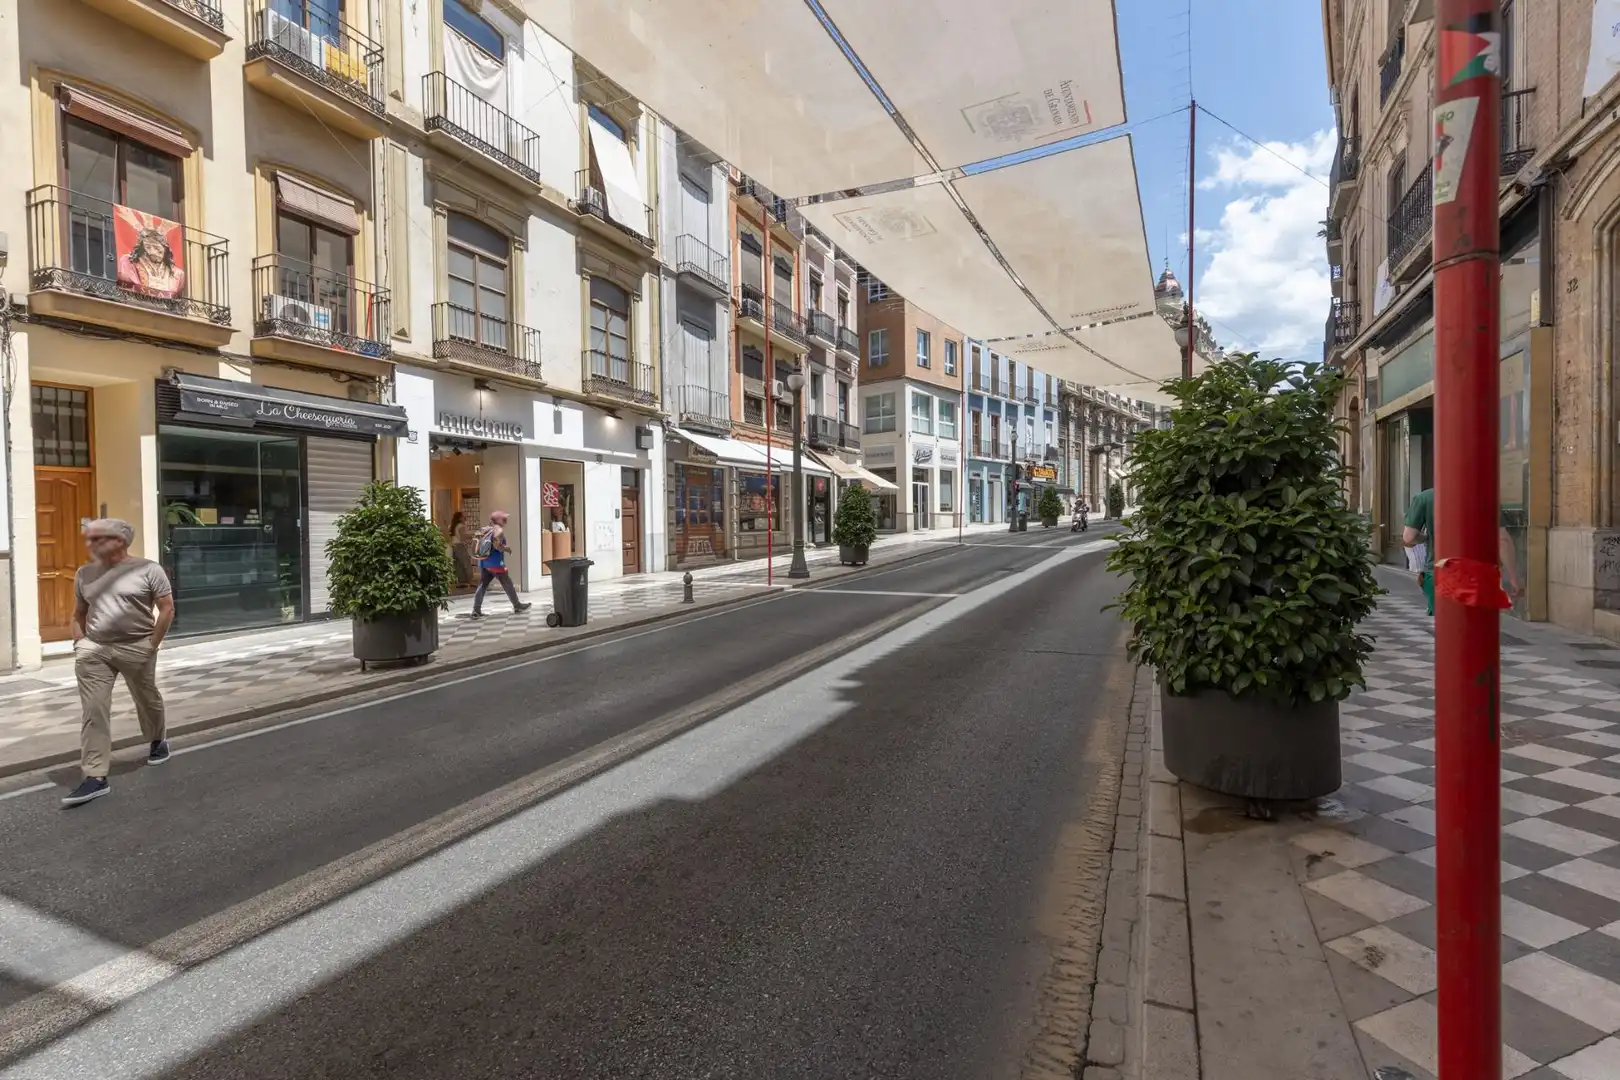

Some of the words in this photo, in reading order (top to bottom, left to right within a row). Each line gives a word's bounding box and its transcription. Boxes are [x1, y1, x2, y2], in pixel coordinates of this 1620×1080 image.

[256, 400, 282, 416] La
[284, 404, 356, 427] Cheesequería
[439, 411, 524, 438] miramira
